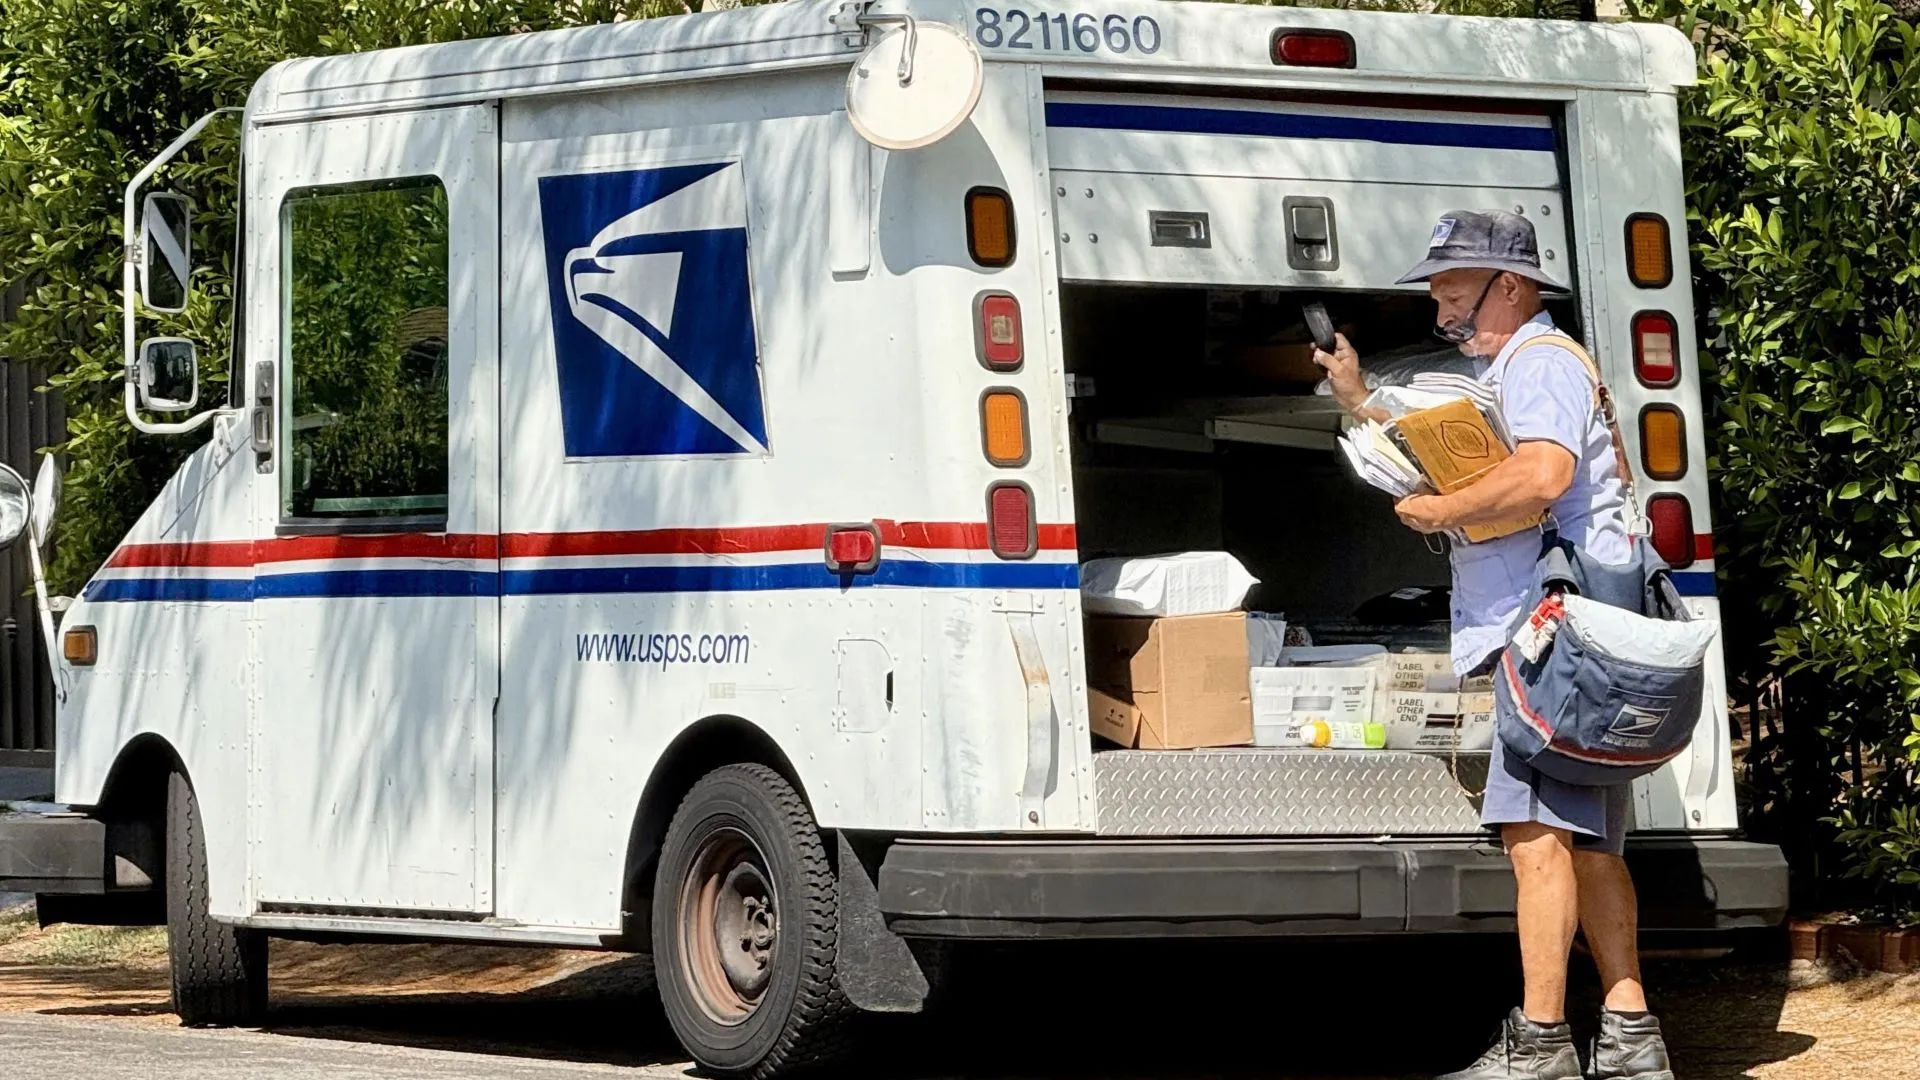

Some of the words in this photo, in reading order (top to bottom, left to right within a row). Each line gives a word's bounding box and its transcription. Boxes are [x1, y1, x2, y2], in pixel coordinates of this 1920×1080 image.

[975, 7, 1161, 54] 8211660
[576, 633, 750, 672] www.usps.com
[1397, 663, 1424, 671] LABEL
[1395, 671, 1424, 680] OTHER
[1399, 698, 1424, 706] LABEL
[1396, 706, 1424, 714] OTHER
[1400, 714, 1417, 722] END
[1474, 714, 1490, 722] END
